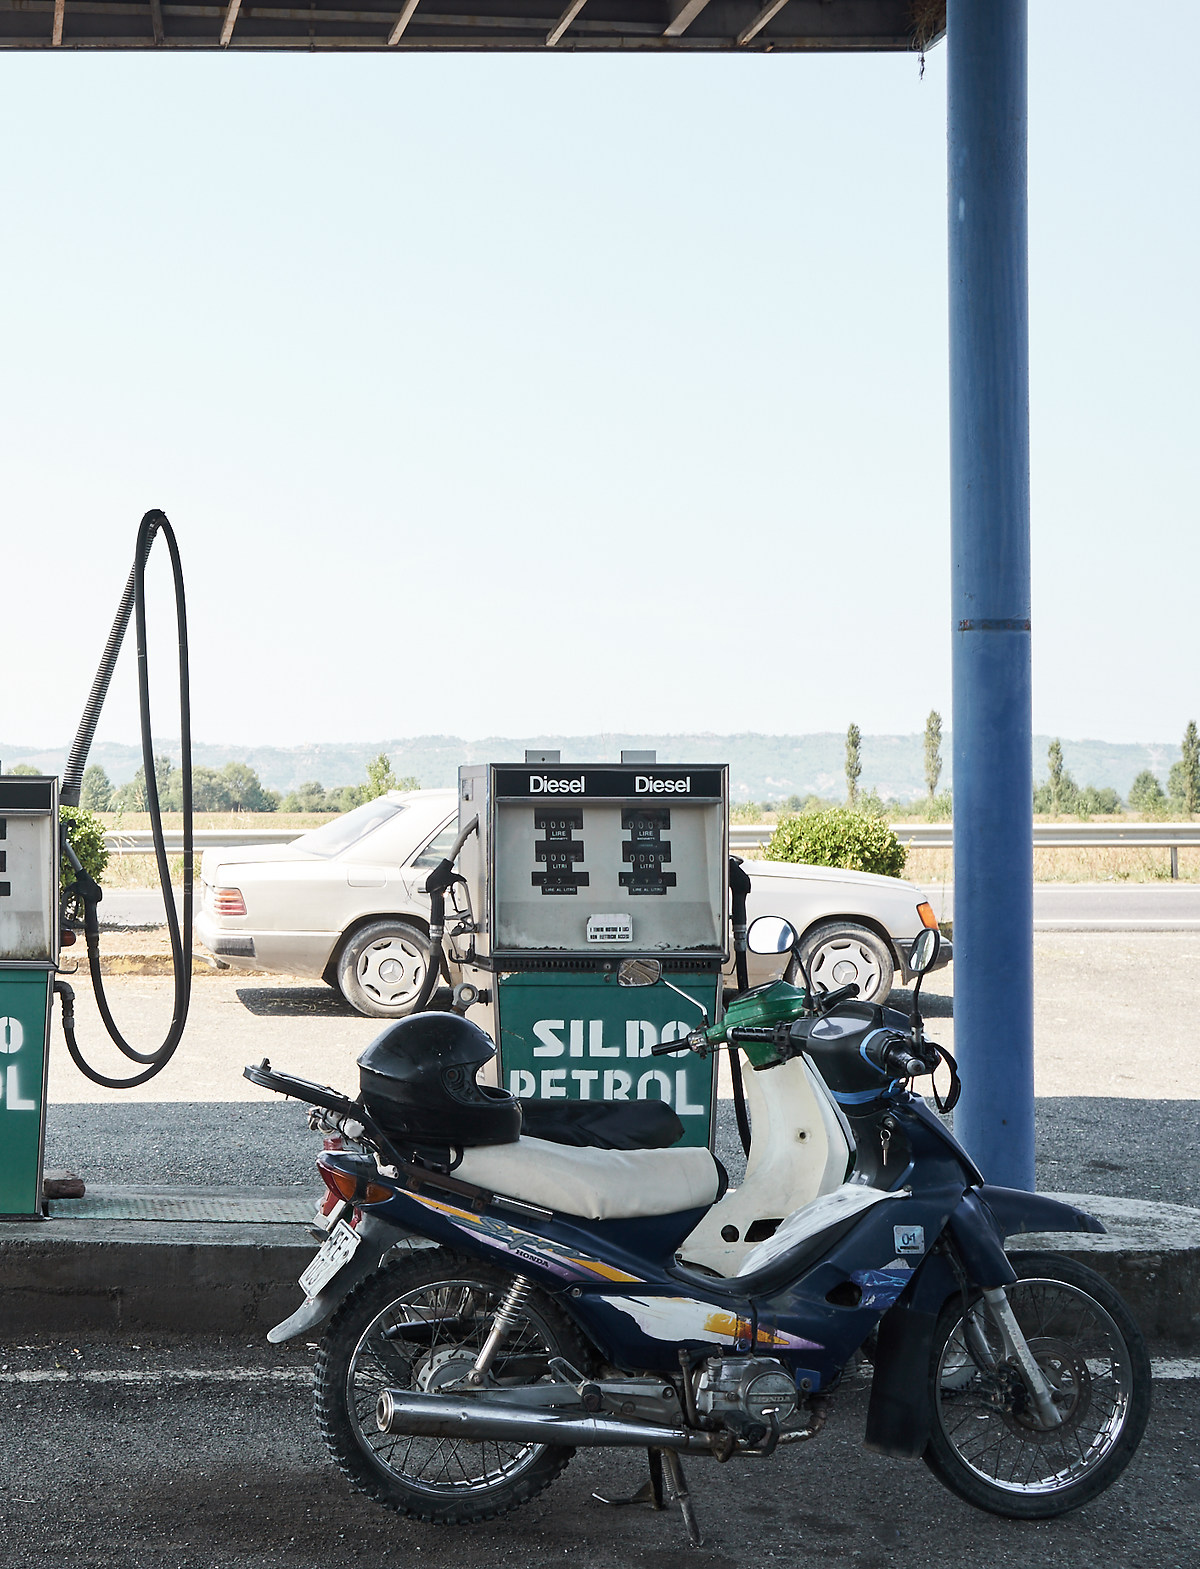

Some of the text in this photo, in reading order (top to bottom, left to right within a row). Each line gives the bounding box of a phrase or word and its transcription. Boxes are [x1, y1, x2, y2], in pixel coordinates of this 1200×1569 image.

[529, 775, 585, 793] Diesel
[635, 776, 691, 793] Diesel
[532, 1019, 693, 1058] SILDO
[509, 1068, 705, 1116] PETROL
[515, 1249, 550, 1268] HONDA
